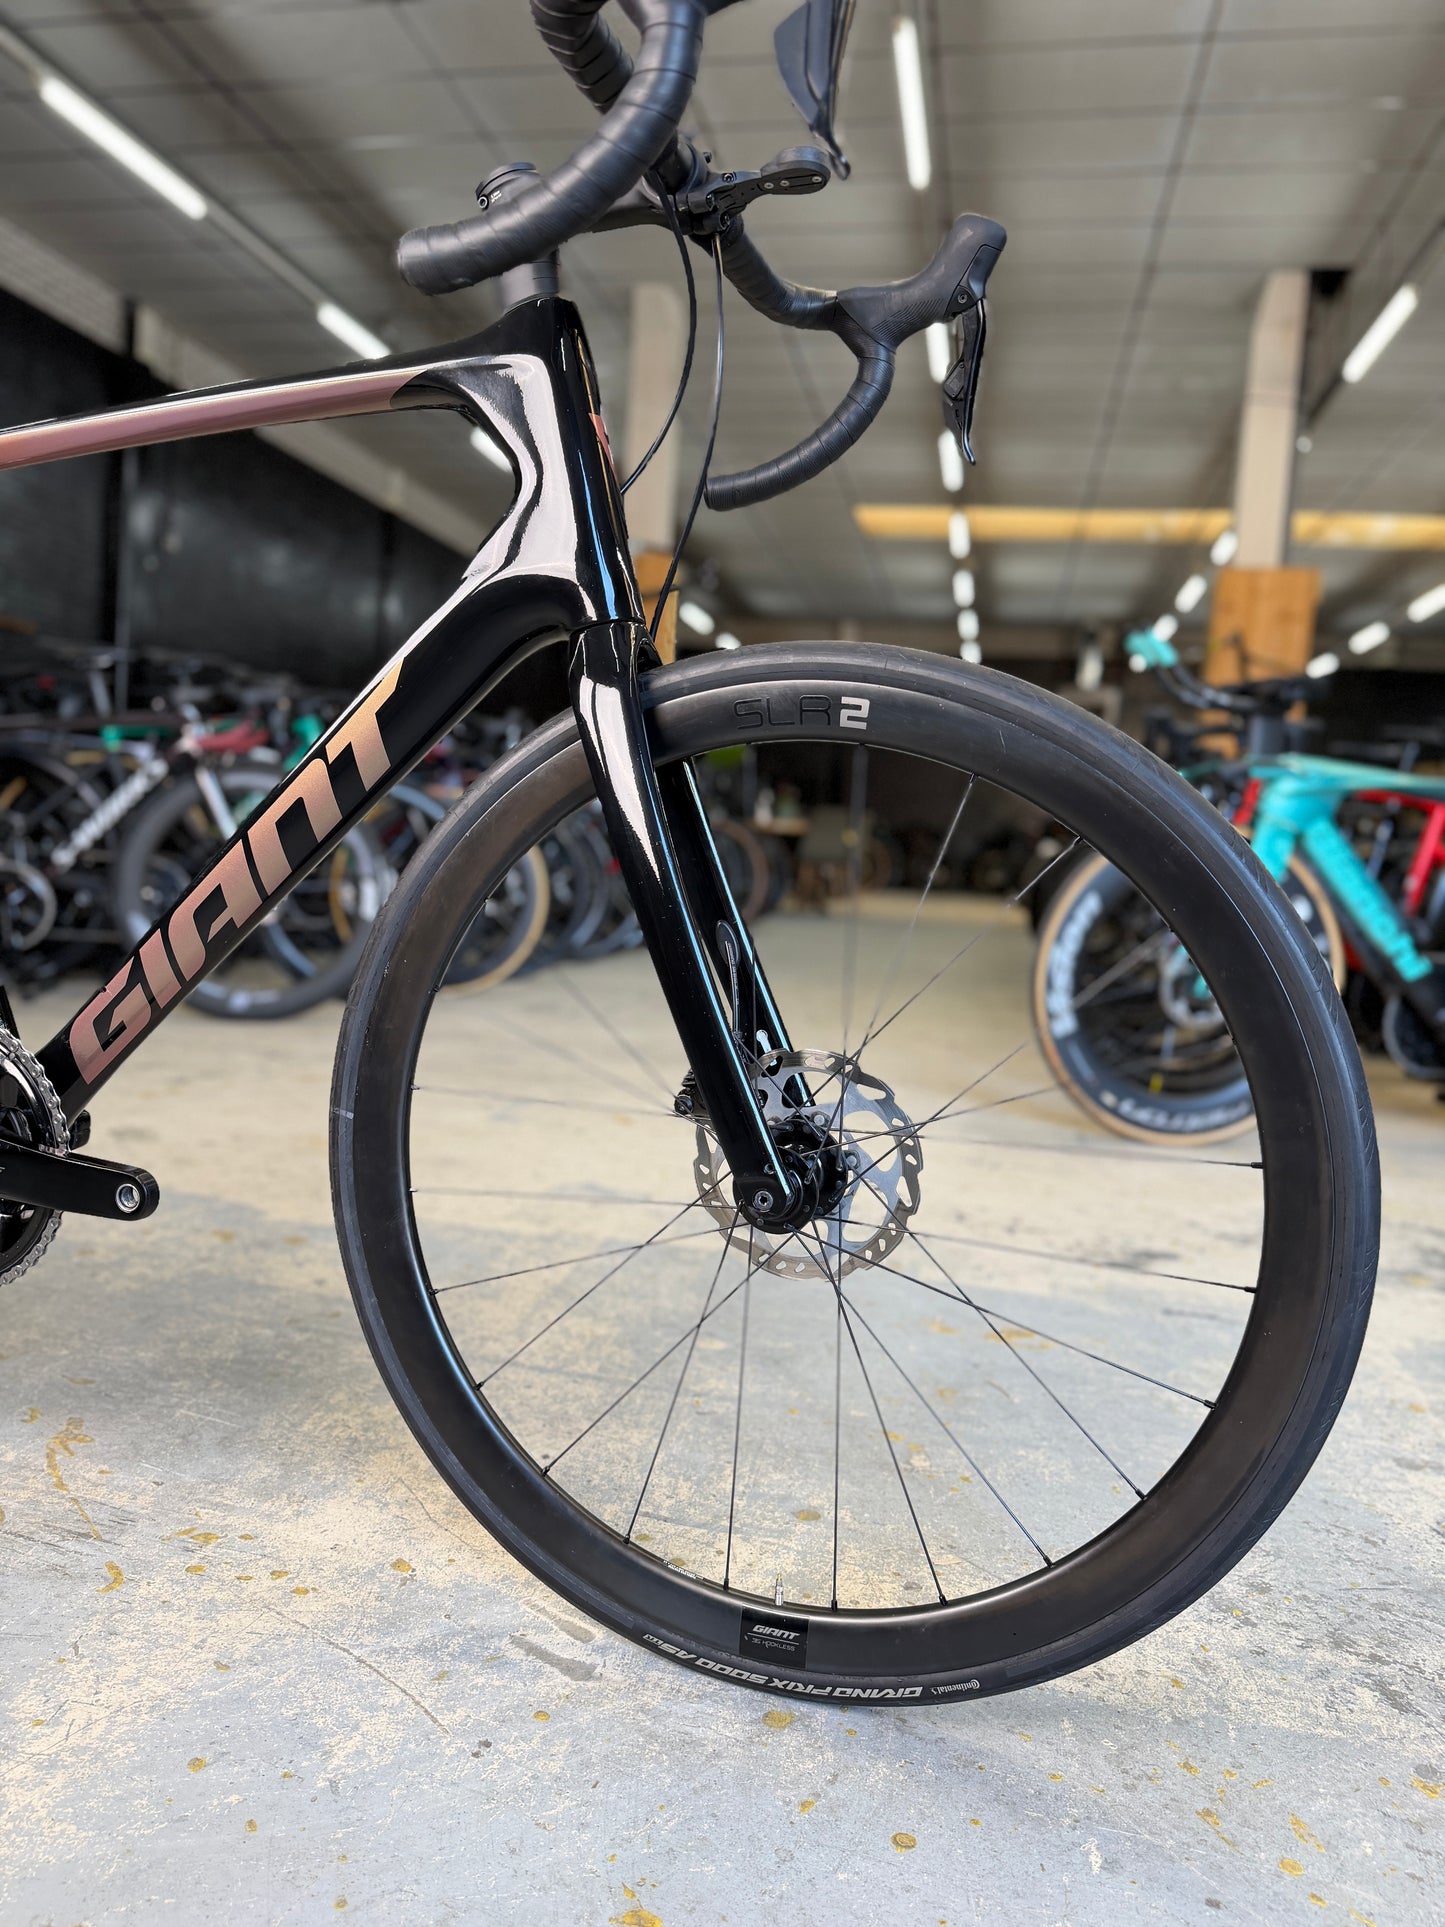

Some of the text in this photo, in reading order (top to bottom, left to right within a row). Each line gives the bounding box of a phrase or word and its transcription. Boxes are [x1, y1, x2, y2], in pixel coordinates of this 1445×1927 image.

[69, 657, 406, 1086] GIANT
[752, 1624, 800, 1640] GIANT
[694, 1657, 769, 1684] 5000
[768, 1677, 832, 1696] PRIX
[832, 1686, 923, 1698] GRAND
